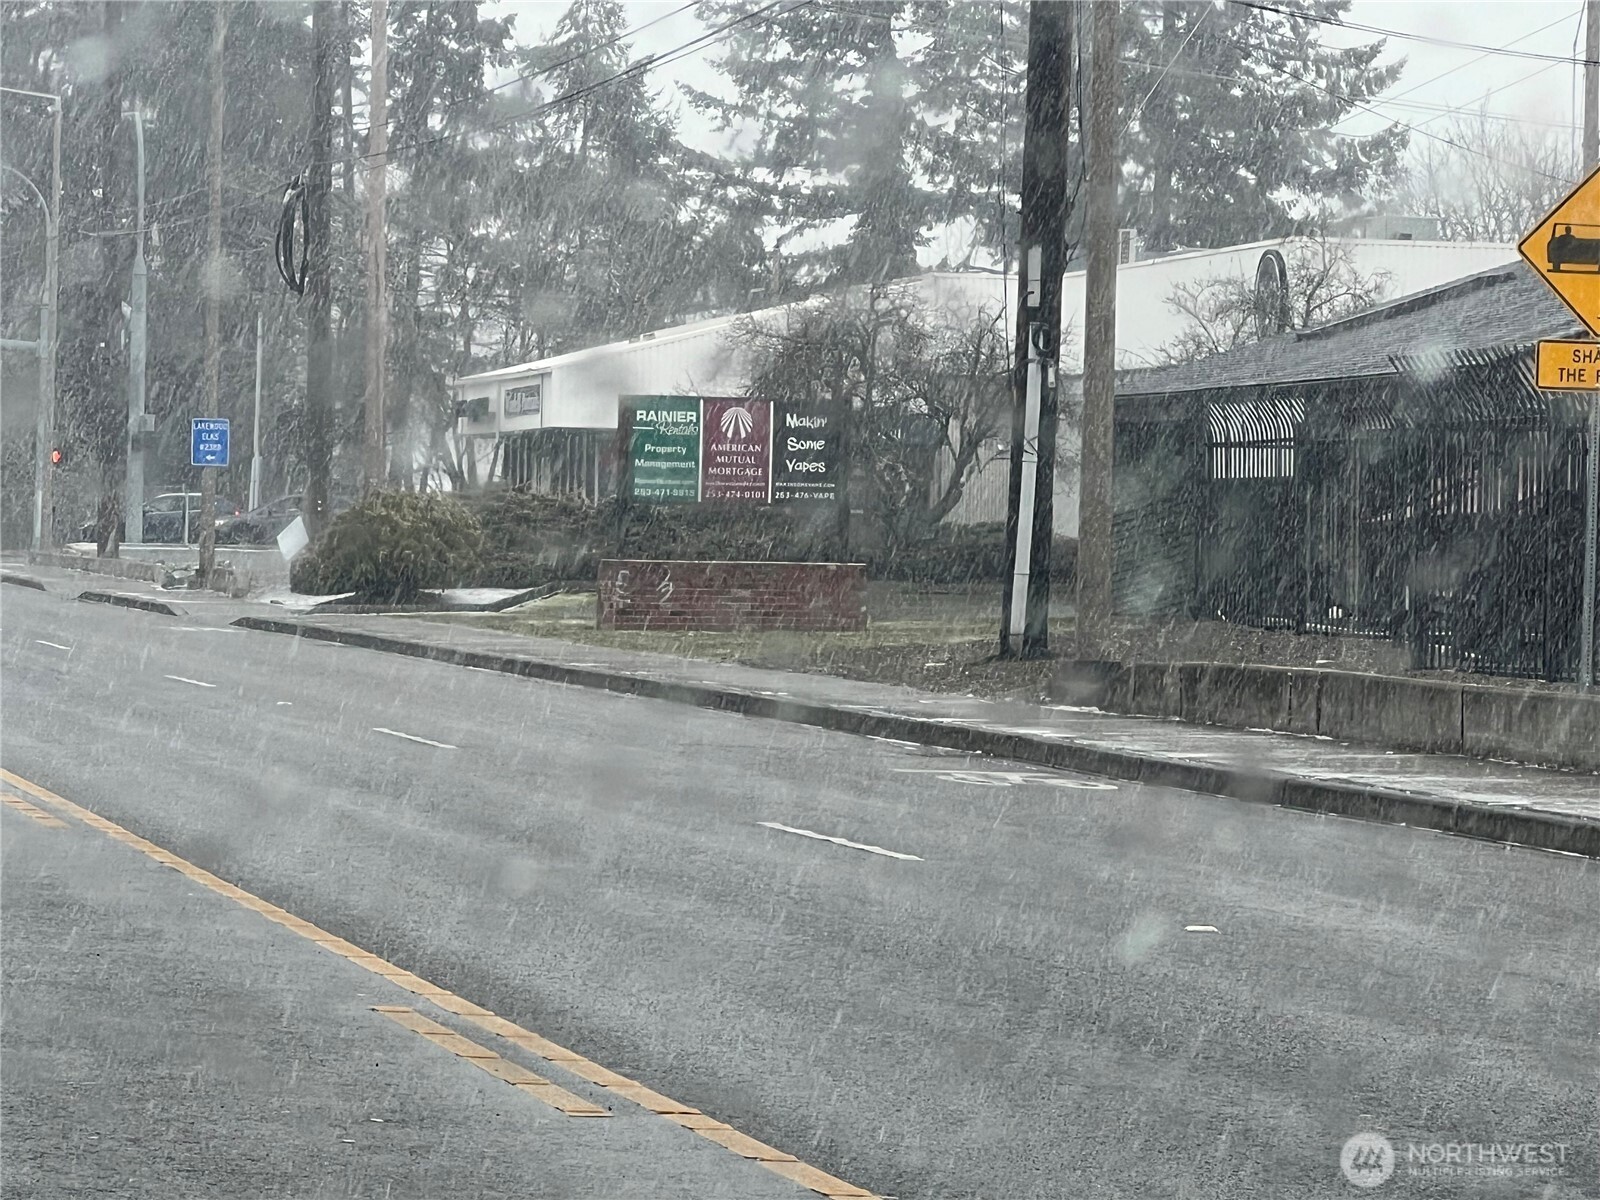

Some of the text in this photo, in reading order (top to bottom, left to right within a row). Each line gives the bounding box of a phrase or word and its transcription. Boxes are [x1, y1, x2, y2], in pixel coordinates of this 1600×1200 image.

[1558, 367, 1586, 382] THE
[636, 410, 697, 422] RAINIER
[785, 413, 828, 429] Makin'
[656, 421, 698, 435] Rentals
[644, 443, 687, 455] Property
[711, 443, 762, 452] AMERICAN
[787, 437, 826, 451] Some
[634, 458, 696, 469] Management
[715, 455, 756, 464] MUTUAL
[785, 458, 826, 473] Vapes
[708, 466, 763, 476] MORTGAGE
